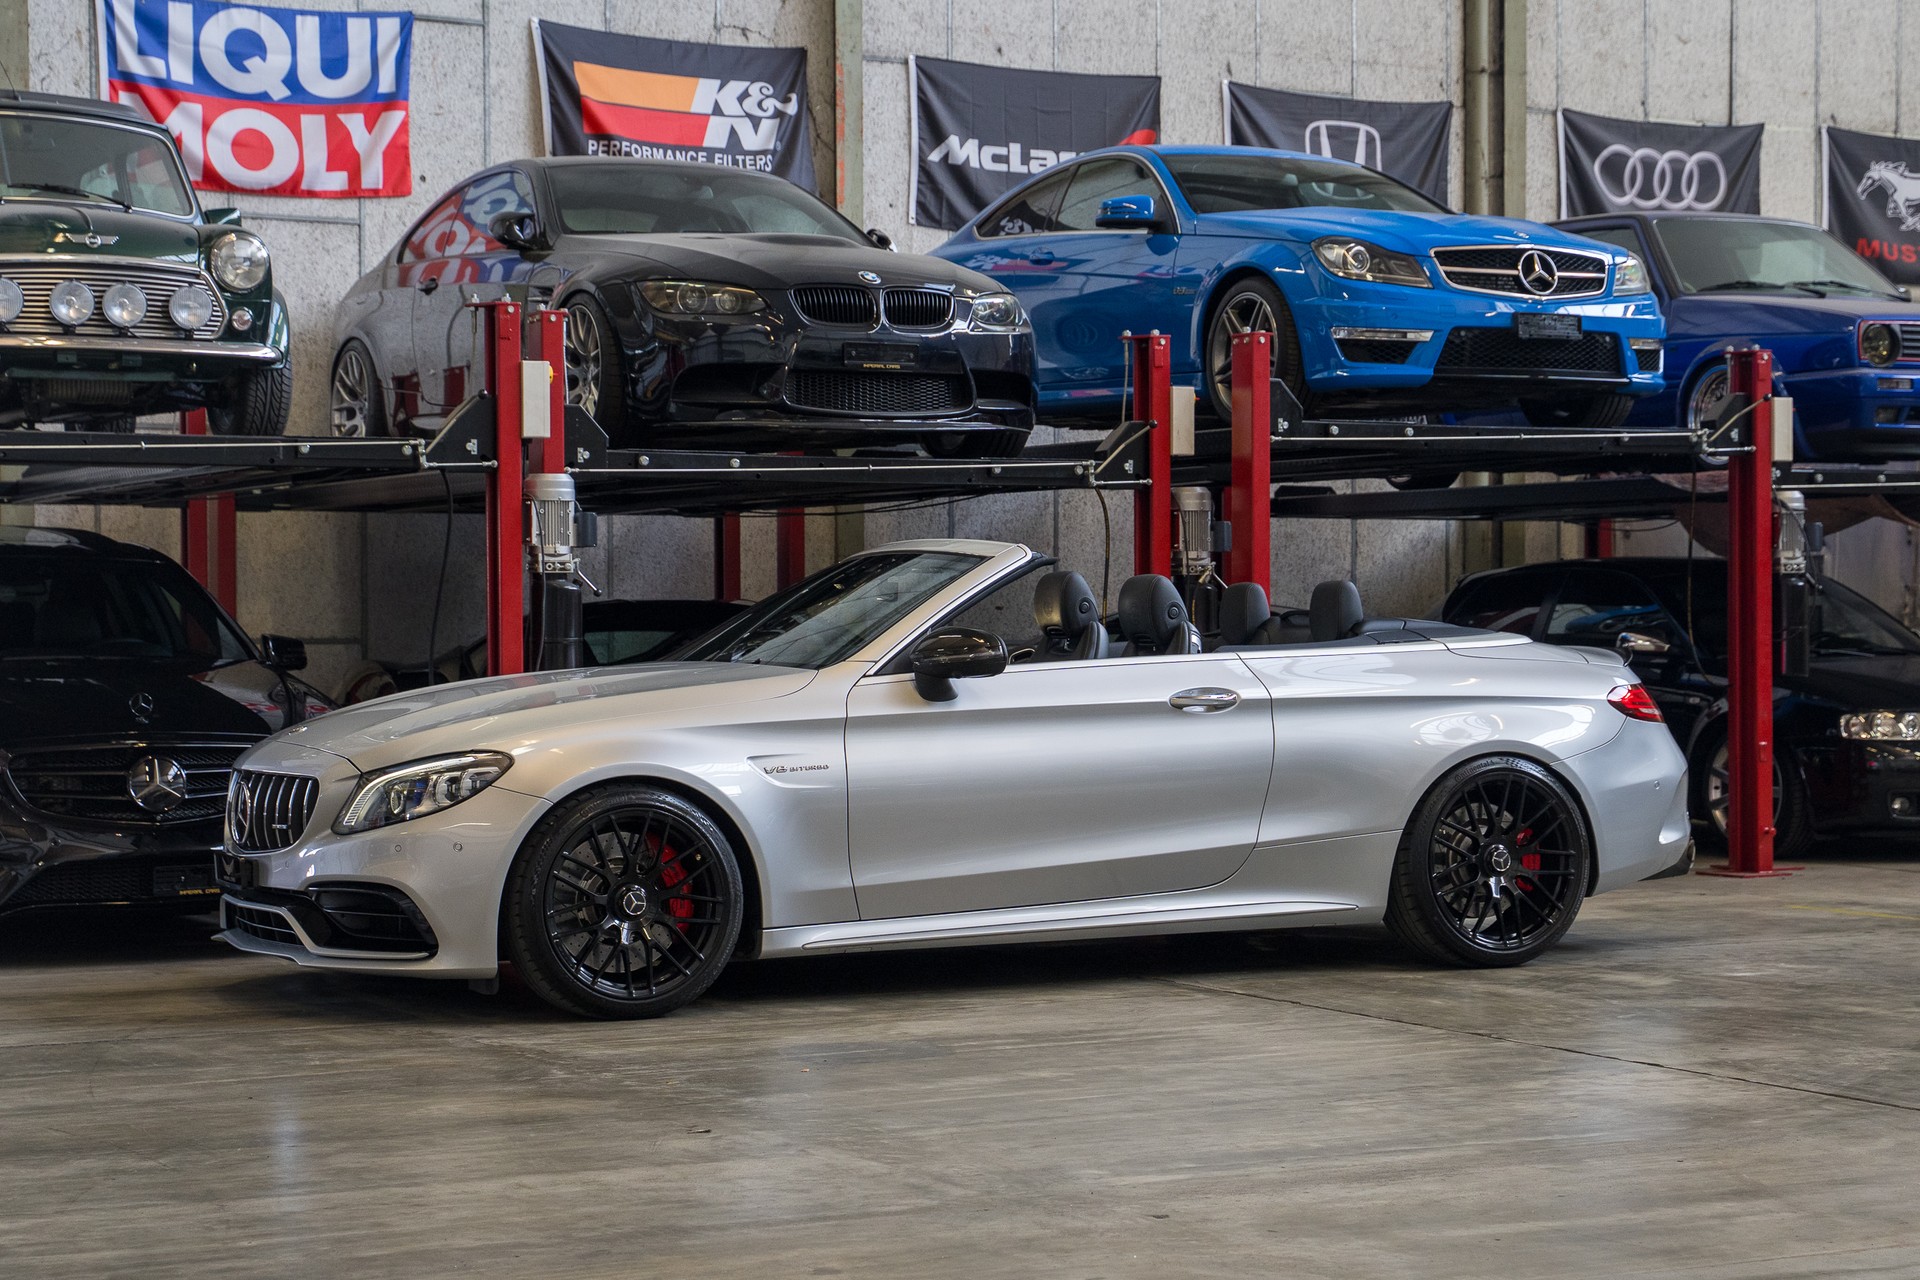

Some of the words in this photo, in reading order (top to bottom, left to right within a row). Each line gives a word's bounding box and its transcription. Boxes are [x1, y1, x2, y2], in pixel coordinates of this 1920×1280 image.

[114, 0, 401, 101] LIQUI
[118, 91, 406, 191] MOLY
[588, 140, 707, 164] PERFORMANCE
[714, 153, 773, 172] FILTERS
[1856, 238, 1920, 263] MUS
[789, 764, 829, 772] BITURBO
